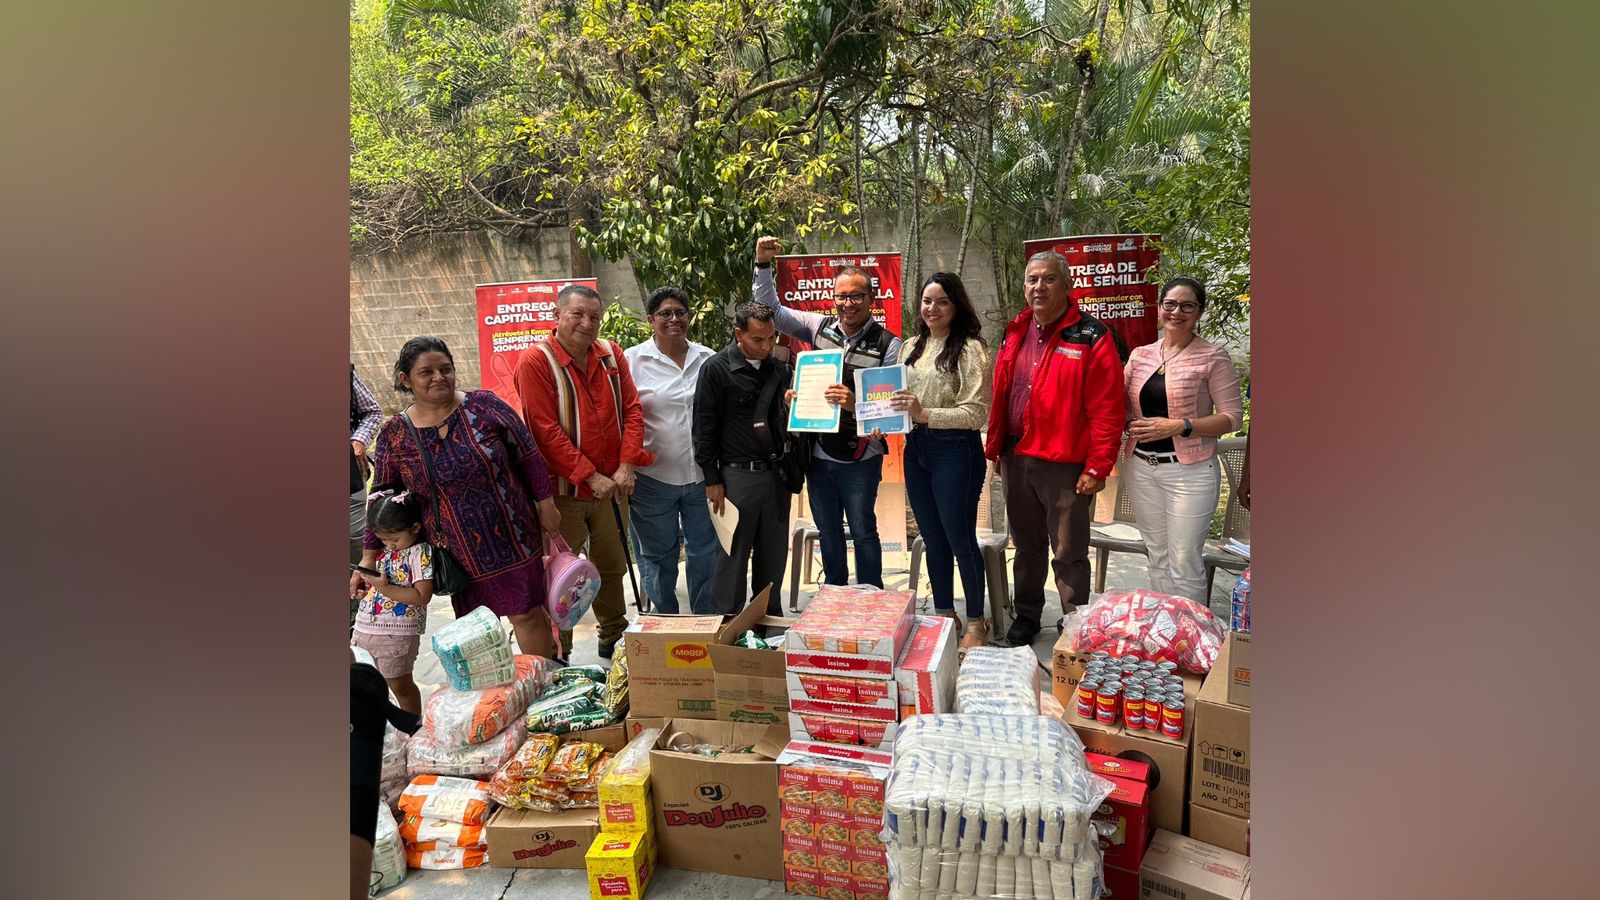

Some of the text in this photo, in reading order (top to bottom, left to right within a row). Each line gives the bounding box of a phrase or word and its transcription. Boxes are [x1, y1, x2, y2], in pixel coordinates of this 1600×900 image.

[1068, 262, 1136, 276] TREGA DE
[1084, 295, 1128, 304] Emprender
[497, 302, 558, 314] ENTREGA
[1108, 301, 1144, 312] porque
[484, 312, 536, 326] CAPITAL
[1100, 309, 1144, 320] CUMPLE!
[675, 648, 704, 657] Maggi
[1056, 676, 1066, 684] 12
[1202, 780, 1220, 790] LOTE
[700, 784, 723, 801] DJ
[1202, 792, 1218, 801] AÑO
